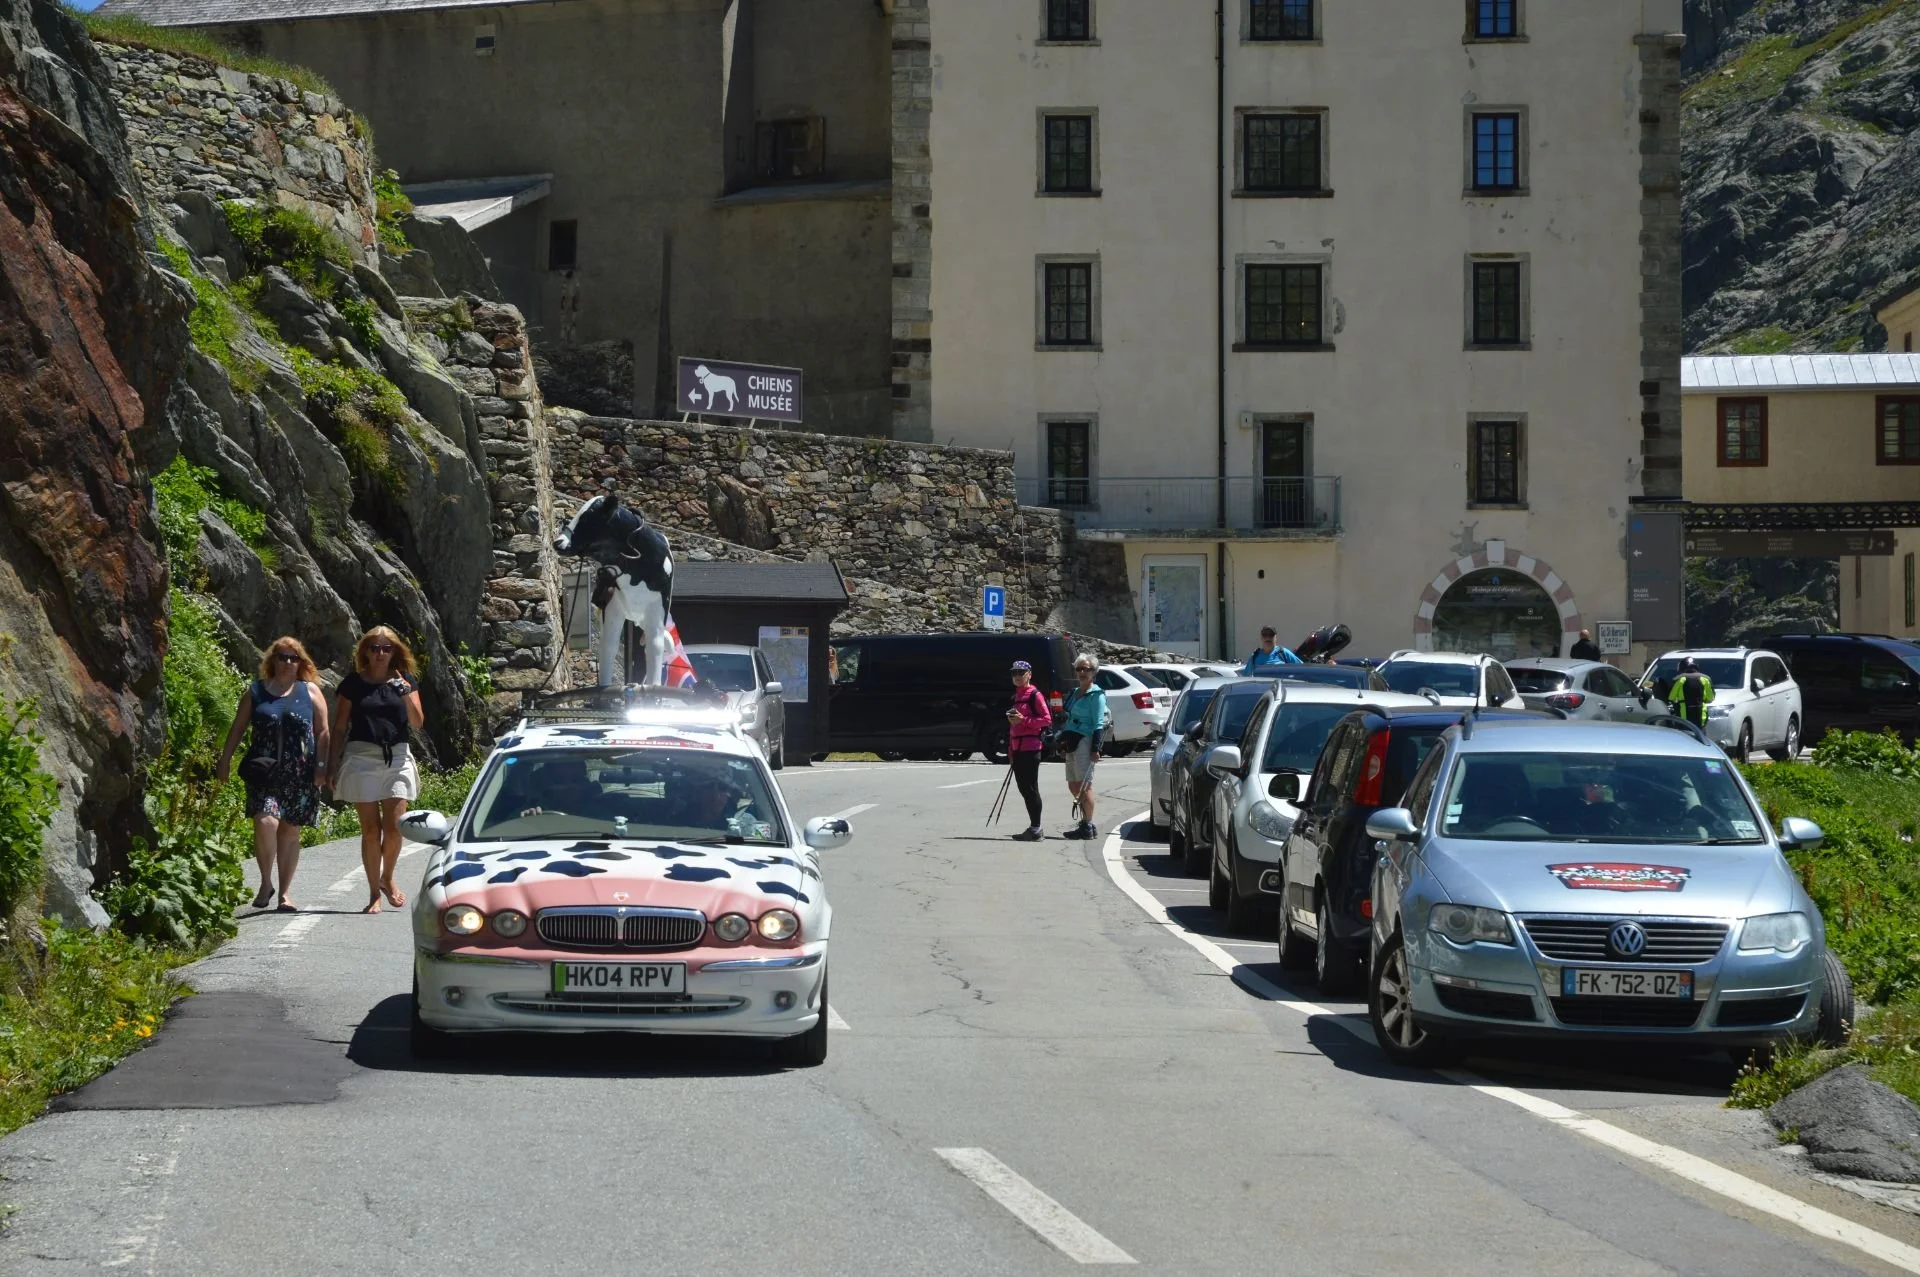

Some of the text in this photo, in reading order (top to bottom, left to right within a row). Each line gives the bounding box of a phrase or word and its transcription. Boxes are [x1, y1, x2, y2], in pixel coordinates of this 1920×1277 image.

[747, 375, 793, 393] CHIENS
[747, 393, 793, 412] MUSÉE
[989, 591, 999, 612] P
[565, 966, 673, 987] HK04 RPV
